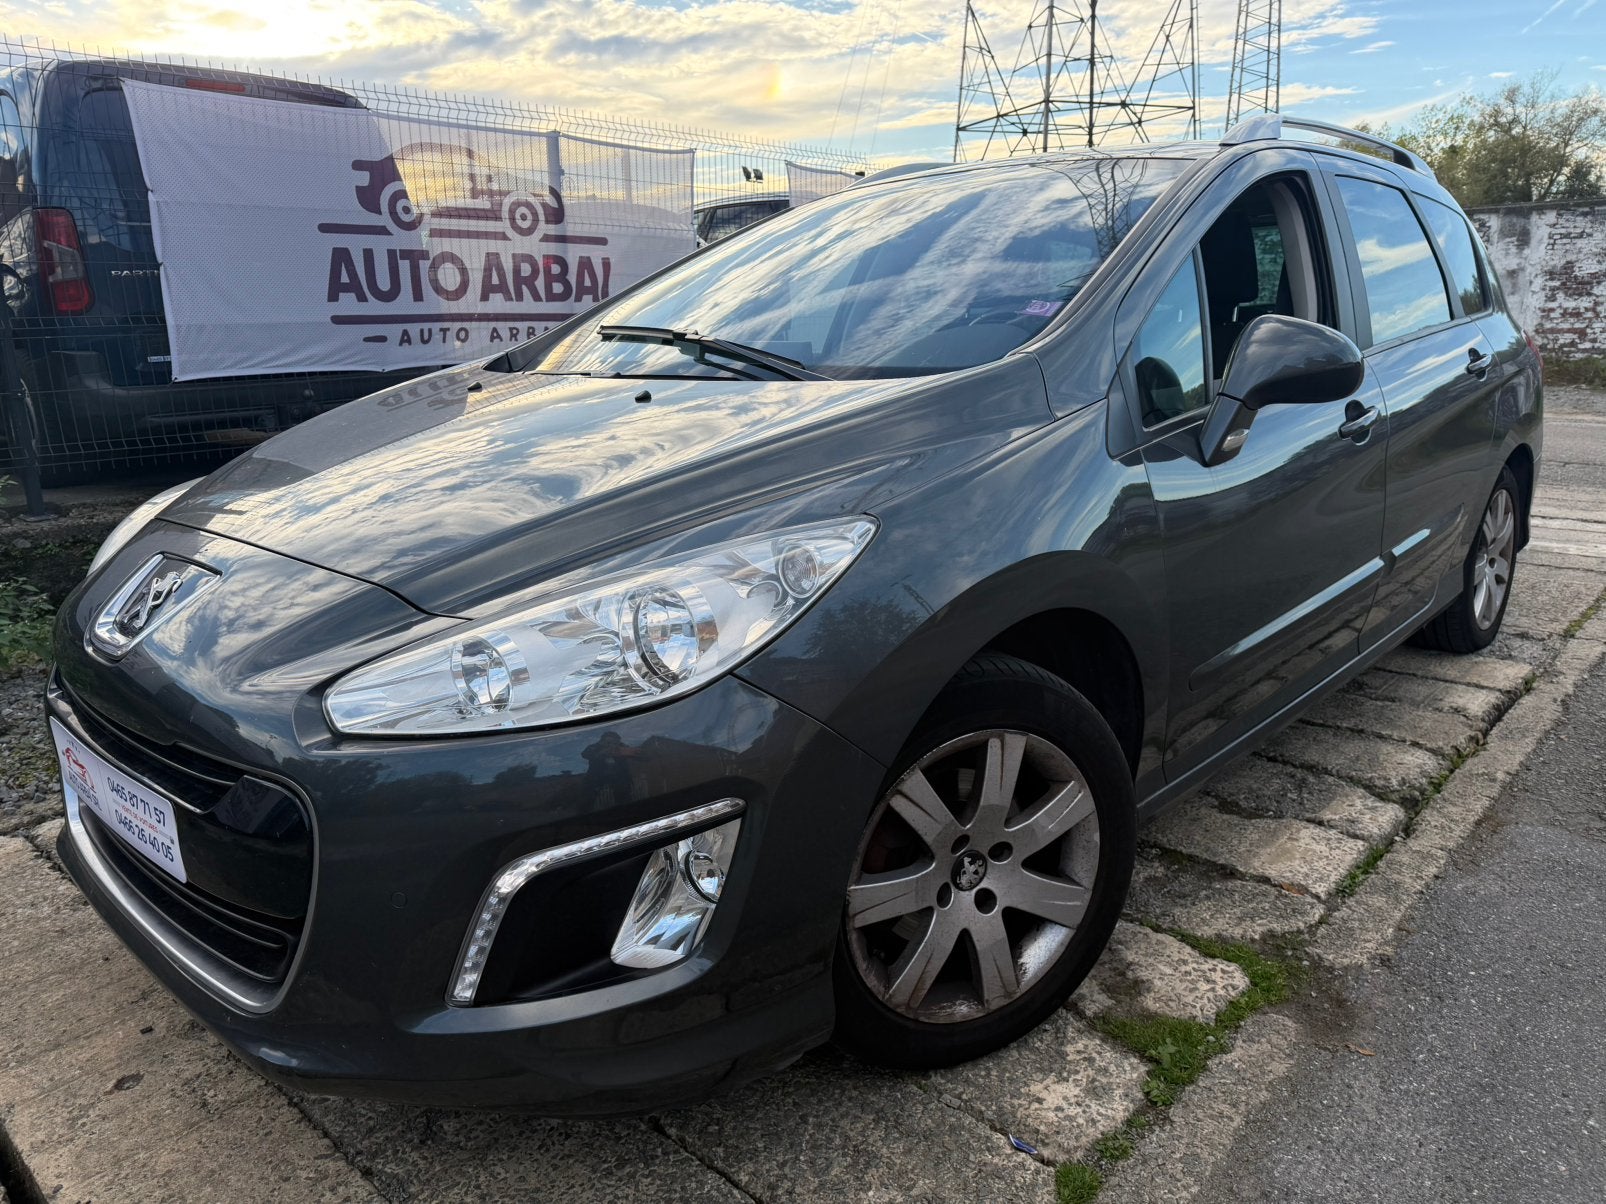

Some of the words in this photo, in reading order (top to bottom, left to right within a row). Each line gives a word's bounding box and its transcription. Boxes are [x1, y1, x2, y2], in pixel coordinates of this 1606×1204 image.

[327, 247, 470, 302] AUTO
[398, 326, 470, 346] AUTO
[107, 776, 128, 802] 0465
[128, 790, 138, 810] 87
[140, 798, 152, 818] 71
[153, 806, 166, 827] 57
[114, 809, 135, 836] 0466
[135, 824, 147, 844] 26
[149, 833, 160, 854] 40
[161, 842, 174, 862] 05
